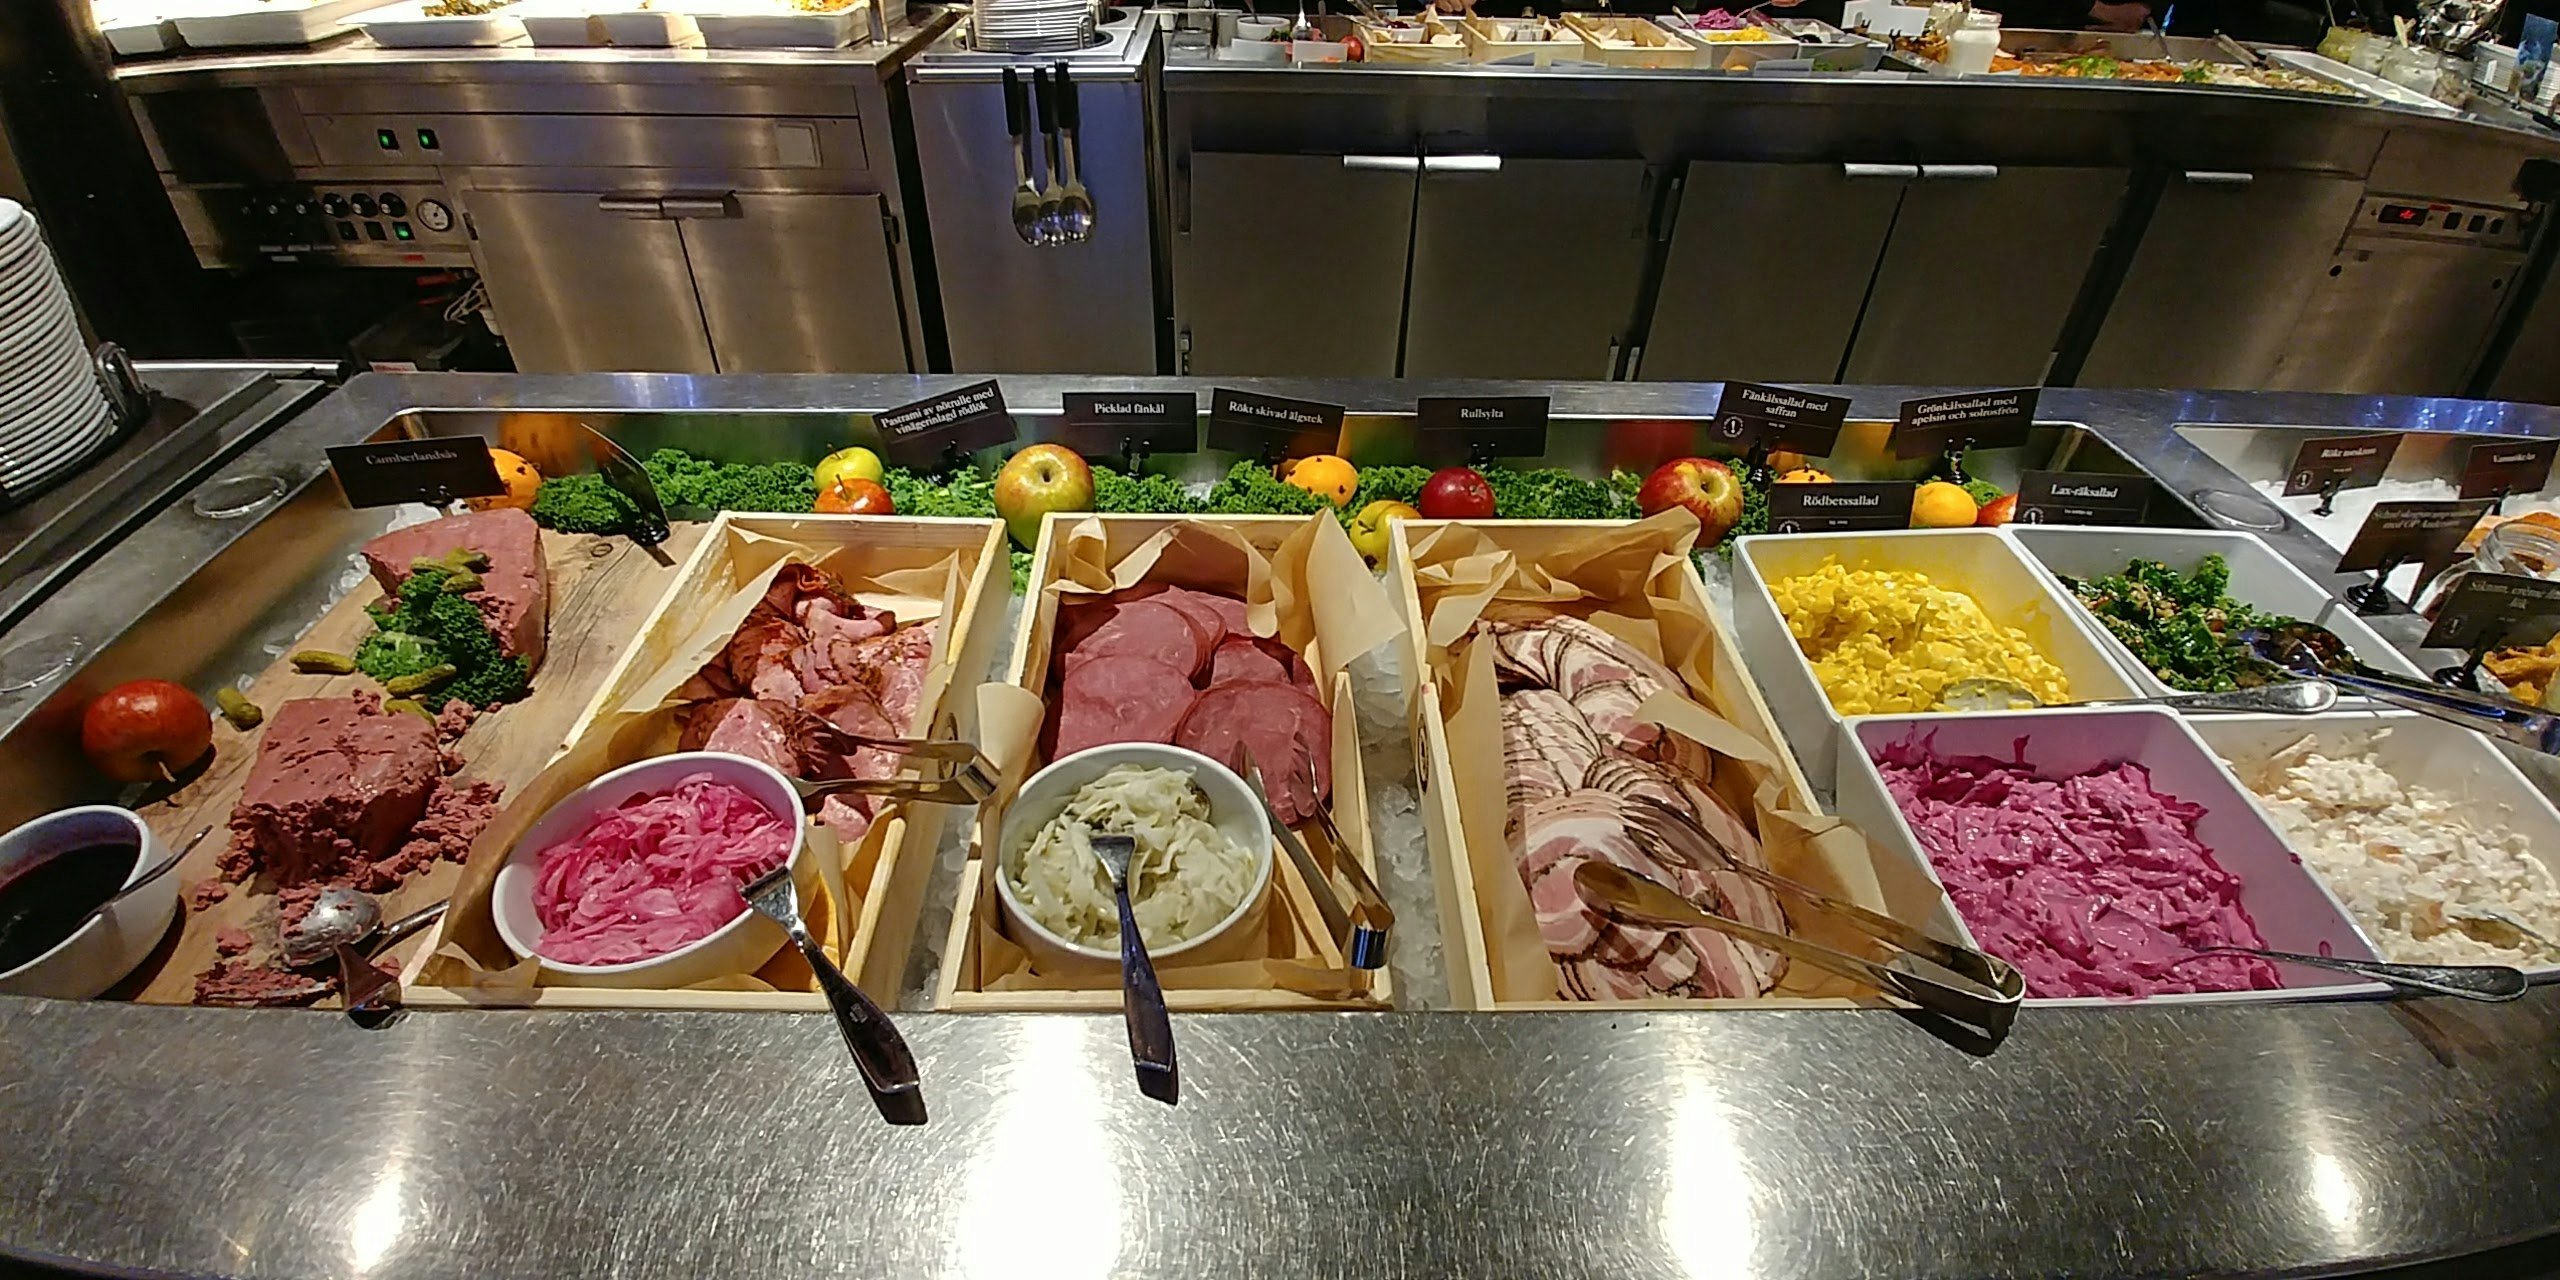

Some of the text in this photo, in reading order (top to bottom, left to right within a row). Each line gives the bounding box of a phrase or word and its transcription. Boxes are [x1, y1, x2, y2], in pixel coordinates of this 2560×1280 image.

[881, 387, 994, 428] Pastrami av nötrulle med
[1094, 403, 1165, 414] Picklad fänkål
[1742, 389, 1828, 412] Fänkålssallad med
[1917, 396, 2018, 414] Grönkålssallad med
[896, 401, 988, 435] vinägerinlagd rödlök
[1229, 401, 1323, 424] Rökt skivad älgstek
[1461, 408, 1504, 420] Rullsylta
[1765, 405, 1797, 418] saffran
[1911, 406, 2019, 427] apelsin och solrosfrön
[365, 449, 458, 465] Cumberlandsås
[2051, 484, 2118, 498] Lax-räksallad
[1803, 494, 1879, 506] Rödbetssallad
